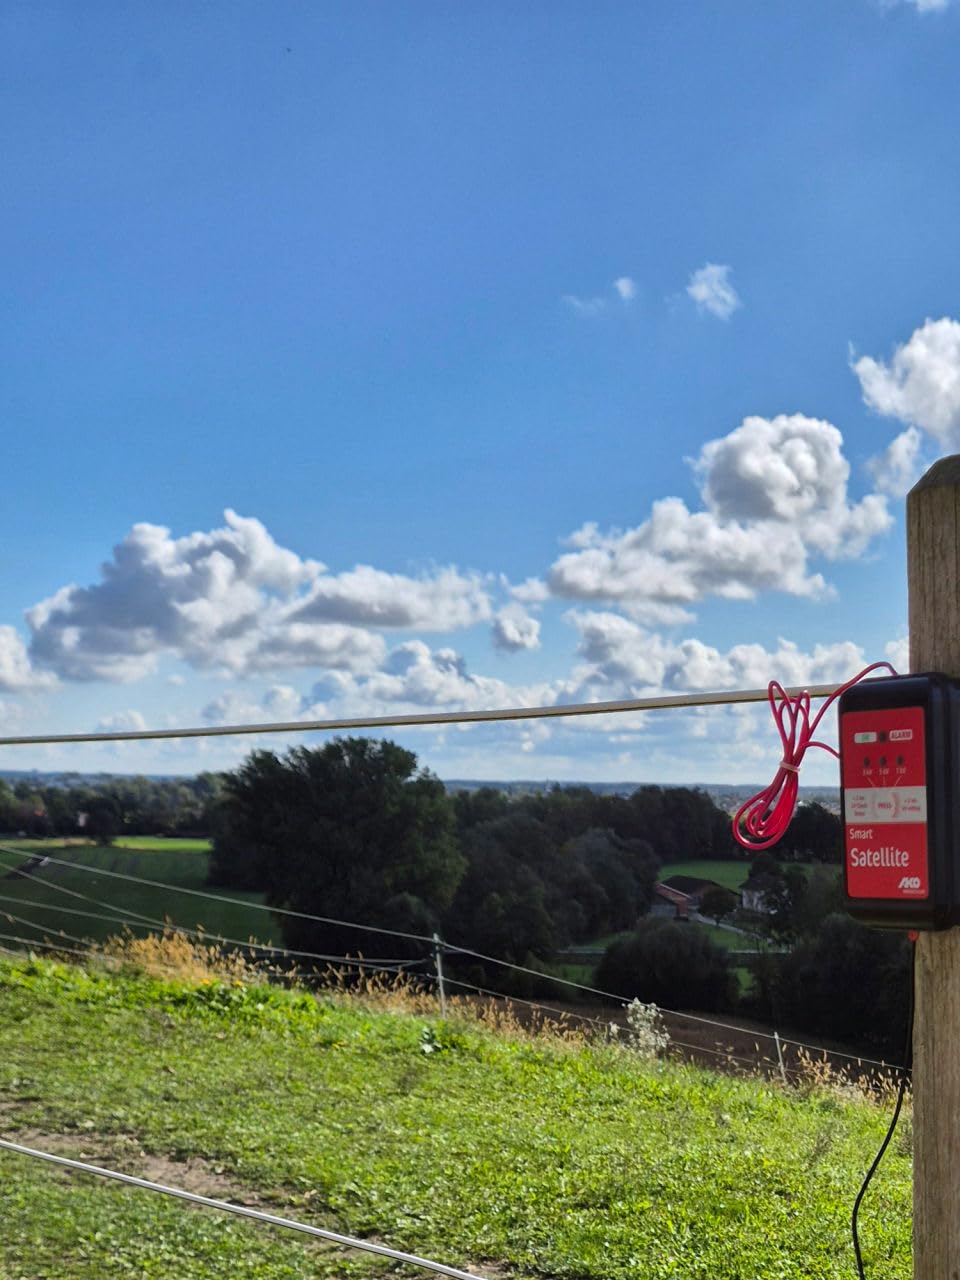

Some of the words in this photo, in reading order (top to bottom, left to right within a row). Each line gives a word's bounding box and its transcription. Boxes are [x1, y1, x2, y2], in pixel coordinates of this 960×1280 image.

[891, 731, 912, 740] ALARM
[849, 828, 873, 840] Smart
[850, 846, 910, 867] Satellite
[898, 876, 921, 889] AKO
